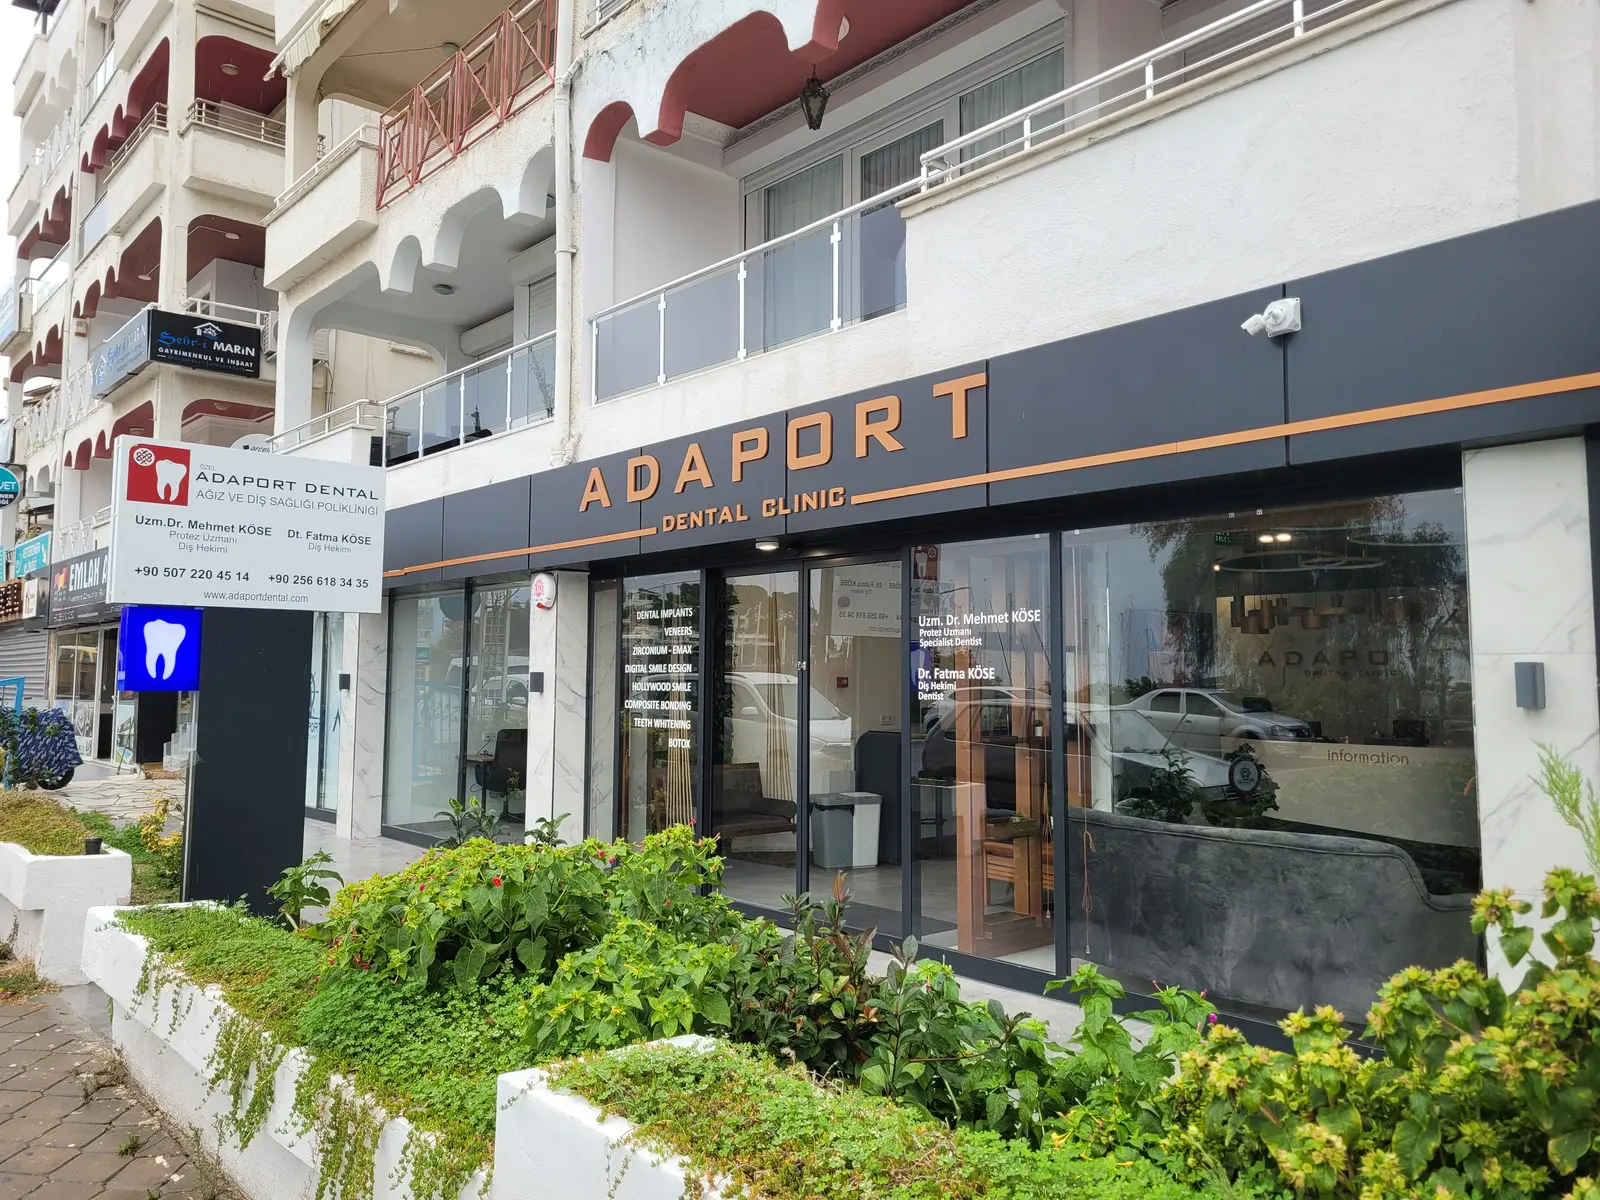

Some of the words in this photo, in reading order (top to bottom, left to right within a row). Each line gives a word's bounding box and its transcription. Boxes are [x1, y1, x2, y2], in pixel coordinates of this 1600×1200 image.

[227, 358, 253, 368] İNŞAAT
[579, 373, 987, 512] ADAPORT
[196, 472, 296, 492] ADAPORT
[305, 483, 380, 500] DENTAL
[196, 488, 225, 501] AĞIZ
[228, 492, 244, 502] VE
[248, 493, 267, 506] DİŞ
[270, 496, 314, 510] SAĞLIĞI
[318, 500, 378, 516] POLİKLİNİĞİ
[662, 503, 750, 533] DENTAL
[762, 486, 846, 518] CLINIC
[135, 515, 184, 528] Uzm.Dr.
[188, 520, 235, 533] Mehmet
[238, 524, 272, 536] KÖSE
[169, 530, 200, 540] Protez
[202, 533, 237, 544] Uzmanı
[287, 529, 302, 539] Dt.
[306, 531, 338, 542] Fatma
[341, 534, 372, 545] KÖSE
[178, 542, 194, 552] Diş
[196, 544, 228, 553] Hekimi
[308, 542, 321, 552] Diş
[324, 544, 351, 553] Hekimi
[69, 557, 100, 591] EMLAK
[135, 566, 158, 576] +90
[163, 567, 186, 578] 507
[190, 569, 213, 580] 220
[216, 570, 232, 581] 45
[236, 572, 250, 581] 14
[268, 574, 289, 584] +90
[293, 575, 313, 585] 256
[317, 576, 336, 586] 618
[339, 578, 352, 587] 34
[356, 579, 369, 588] 35
[204, 591, 308, 602] www.adaportdental.com
[636, 610, 660, 620] DENTAL
[660, 608, 692, 618] IMPLANTS
[918, 616, 943, 627] Uzm.
[946, 614, 960, 626] Dr.
[964, 612, 1009, 625] Mehmet
[1012, 608, 1041, 622] KÖSE
[664, 627, 692, 636] VENEERS
[920, 628, 942, 637] Protez
[944, 628, 971, 636] Uzmanı
[919, 638, 953, 648] Specialist
[955, 637, 982, 646] Dentist
[632, 646, 667, 656] ZIRCONIUM
[673, 645, 692, 654] EMAX
[1258, 650, 1389, 667] ADAPO
[625, 664, 647, 674] DIGITAL
[649, 664, 667, 673] SMILE
[668, 664, 692, 673] DESIGN
[918, 667, 932, 680] Dr.
[934, 667, 965, 680] Fatma
[968, 665, 995, 680] KÖSE
[632, 682, 670, 692] HOLLYWOOD
[672, 682, 691, 691] SMILE
[918, 682, 930, 692] Diş
[930, 682, 956, 690] Hekimi
[918, 692, 944, 701] Dentist
[624, 700, 659, 709] COMPOSITE
[661, 701, 691, 710] BONDING
[634, 718, 652, 728] TEETH
[654, 719, 691, 730] WHITENING
[668, 738, 691, 749] BOTOX
[1327, 749, 1409, 764] information
